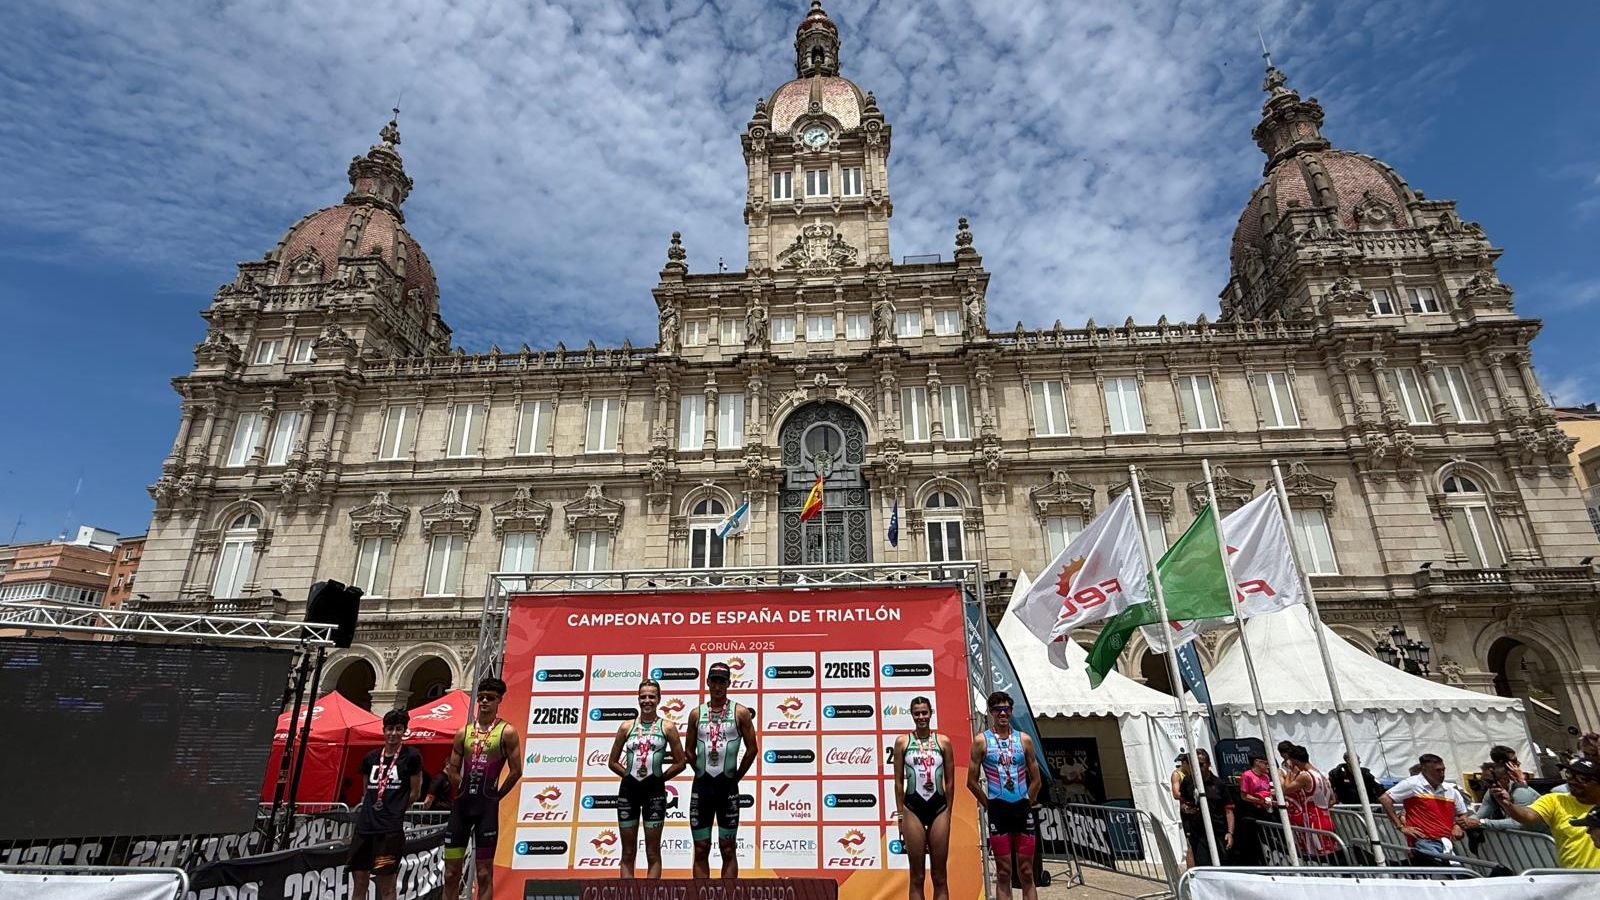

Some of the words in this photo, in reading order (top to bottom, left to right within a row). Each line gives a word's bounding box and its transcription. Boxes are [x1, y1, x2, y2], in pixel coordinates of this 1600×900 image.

[567, 612, 685, 627] CAMPEONATO
[689, 611, 712, 625] DE
[716, 607, 784, 624] ESPAÑA
[788, 609, 811, 623] DE
[815, 604, 901, 622] TRIATLÓN
[689, 643, 697, 651] A
[699, 639, 746, 651] CORUÑA
[748, 641, 776, 650] 2025
[606, 669, 642, 678] Iberdrola
[824, 661, 871, 679] 226ERS
[532, 707, 580, 725] 226ERS
[541, 752, 577, 764] Iberdrola
[768, 799, 811, 811] Halcón
[522, 811, 569, 821] Fetri
[790, 811, 811, 819] viajes
[828, 856, 876, 867] Fetri
